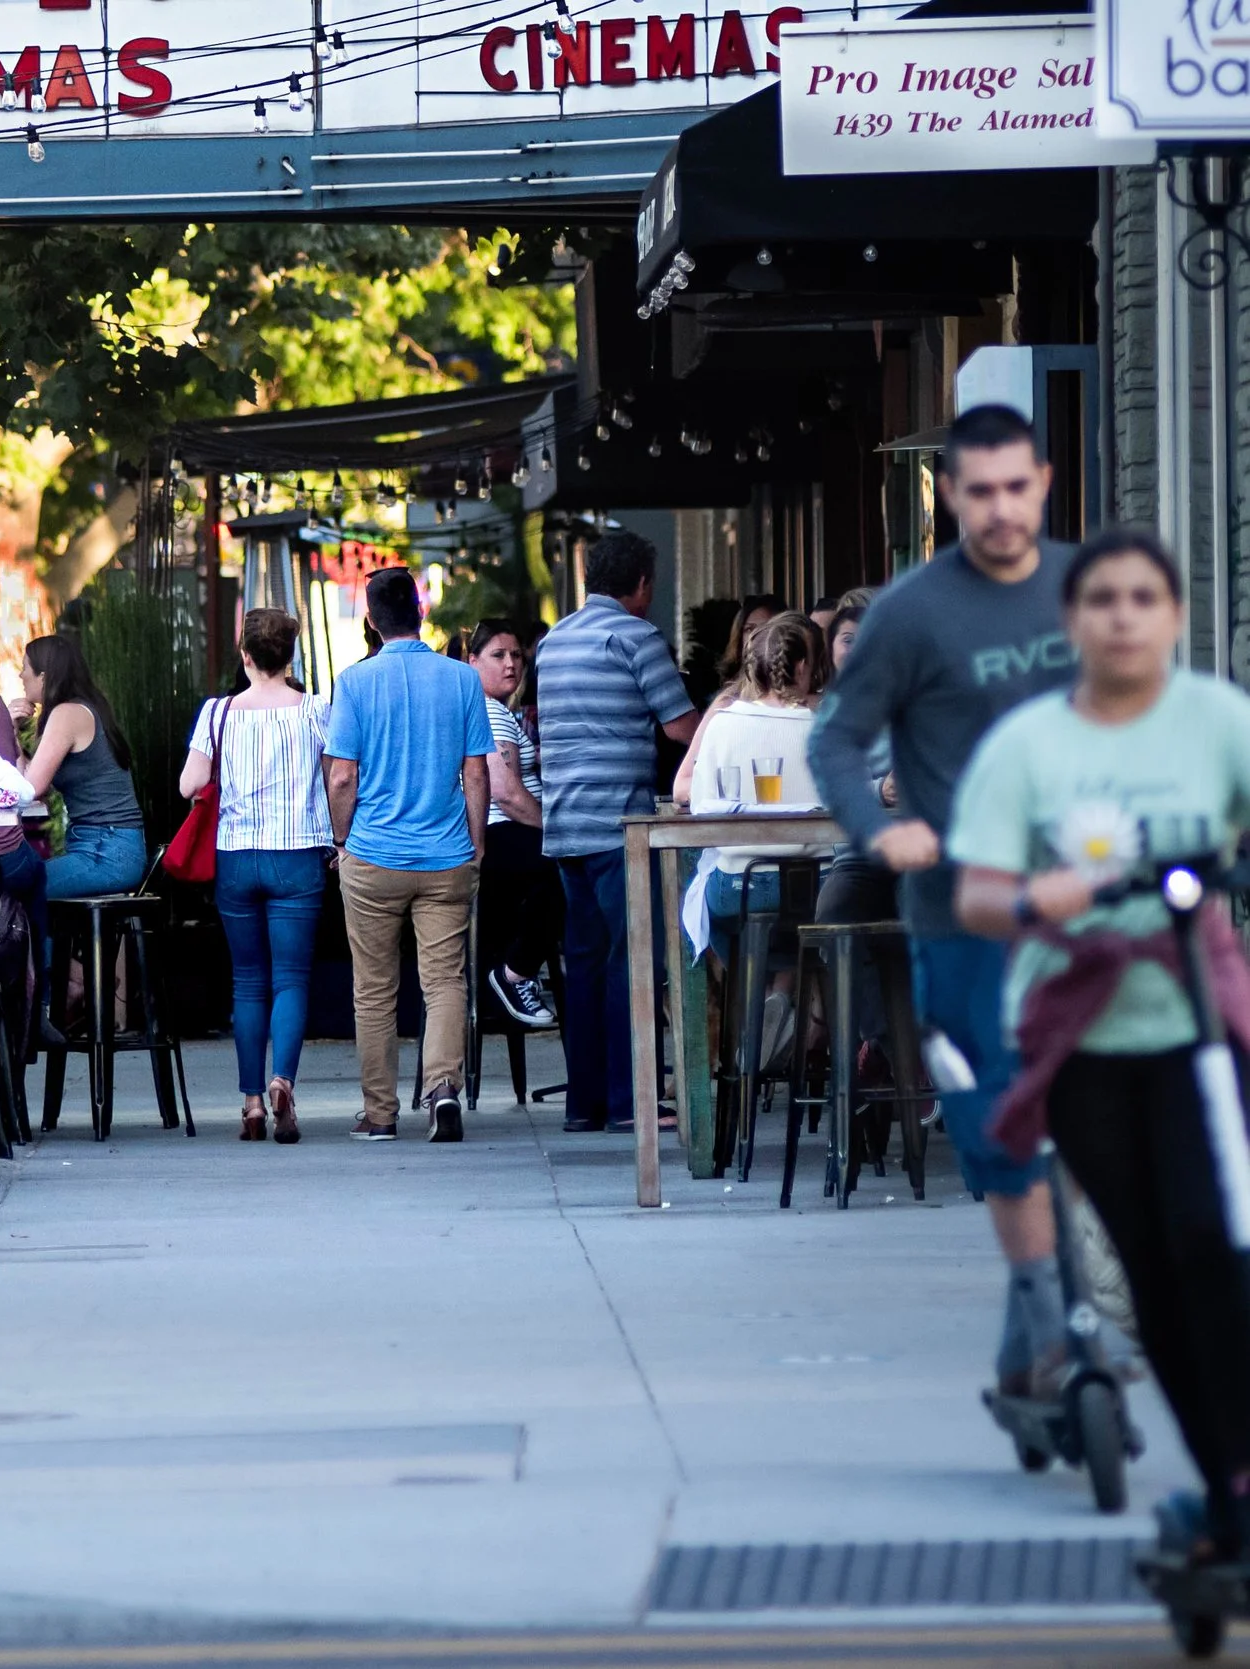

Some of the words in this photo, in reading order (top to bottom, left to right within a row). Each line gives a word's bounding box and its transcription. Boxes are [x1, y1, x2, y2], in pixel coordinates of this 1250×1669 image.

[806, 65, 878, 95] Pro
[898, 62, 1017, 99] Image
[833, 112, 893, 137] 1439
[907, 111, 962, 133] The
[978, 107, 1097, 131] Alamed
